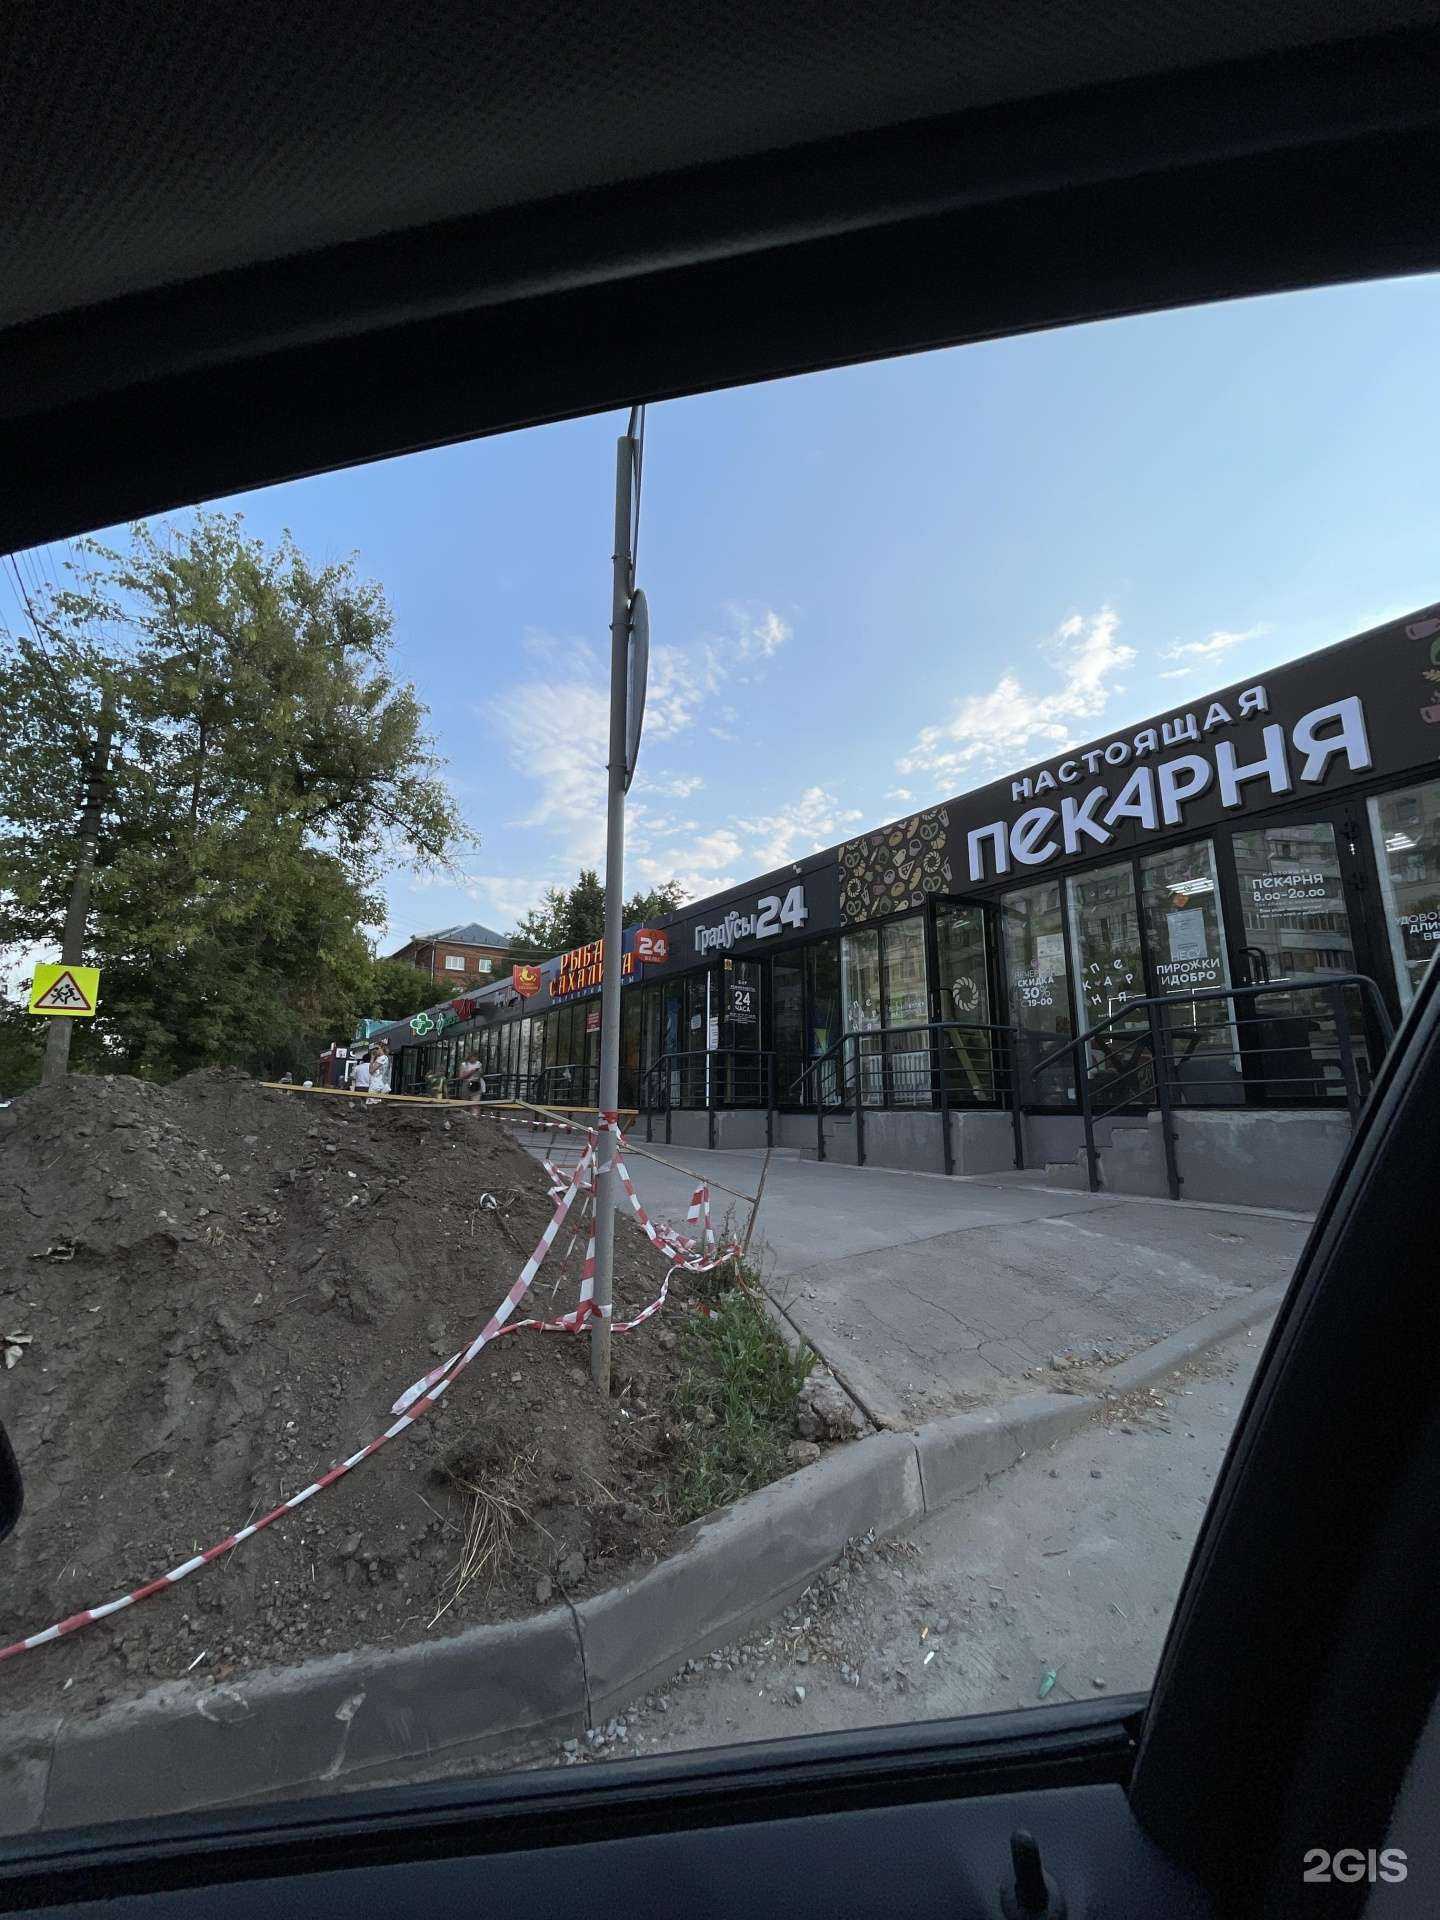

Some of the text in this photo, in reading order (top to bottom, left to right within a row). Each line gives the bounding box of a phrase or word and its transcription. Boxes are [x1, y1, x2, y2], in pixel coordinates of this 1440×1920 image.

[1011, 685, 1269, 802] НАСТОЯЩАЯ
[638, 936, 666, 957] 24
[560, 938, 604, 976] РЫБА
[1156, 957, 1221, 976] ПИРОЖКИ
[1017, 975, 1055, 987] СКИДКА
[734, 990, 751, 1006] 24
